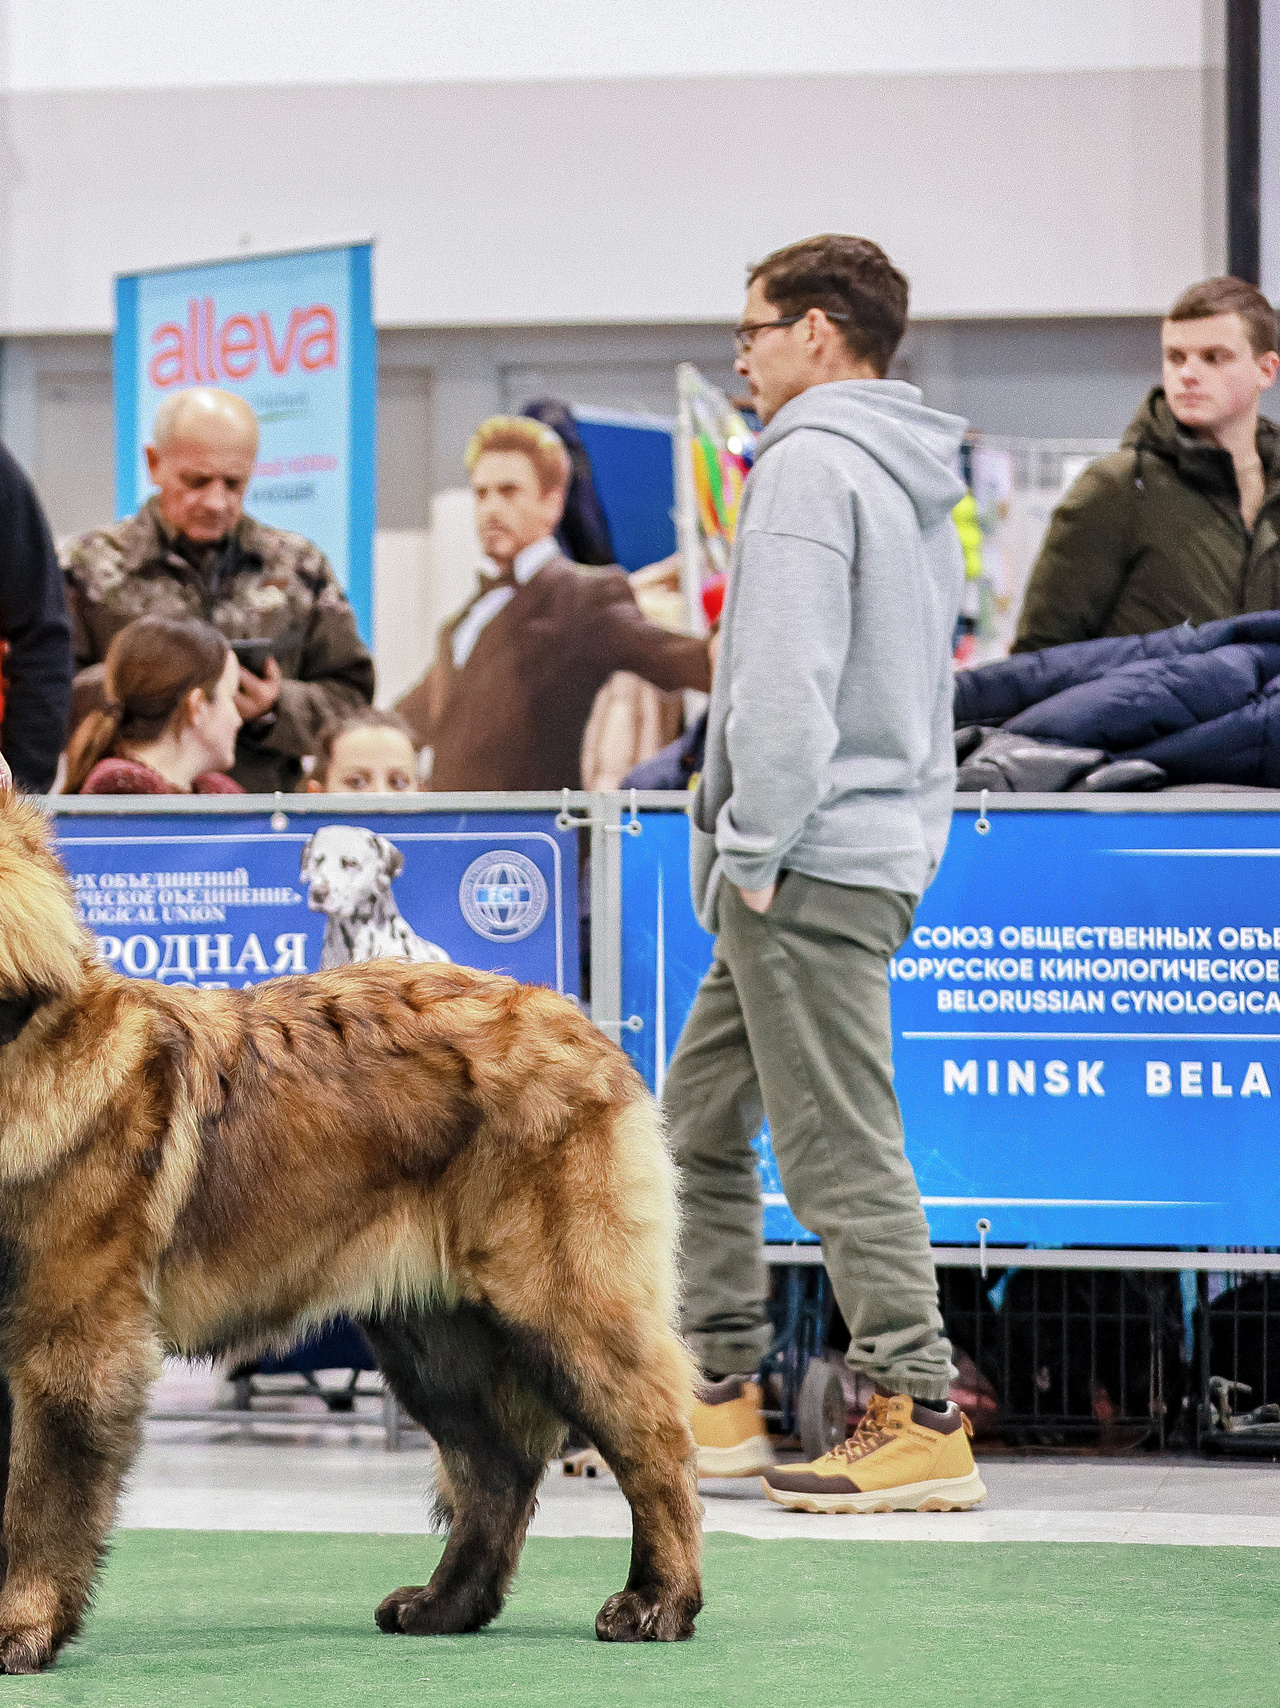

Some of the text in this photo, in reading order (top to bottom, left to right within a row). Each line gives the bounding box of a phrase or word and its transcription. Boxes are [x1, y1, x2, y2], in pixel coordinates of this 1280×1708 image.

[148, 296, 338, 388] alleva
[161, 904, 227, 924] UNION
[913, 926, 994, 950] СОЮЗ
[999, 926, 1211, 952] ОБЩЕСТВЕННЫХ
[96, 932, 309, 984] РОДНАЯ
[1040, 957, 1279, 982] КИНОЛОГИЧЕСКОЕ
[937, 988, 1280, 1014] BELORUSSIAN CYNOLOGICA
[943, 1059, 1271, 1097] MINSK BELA
